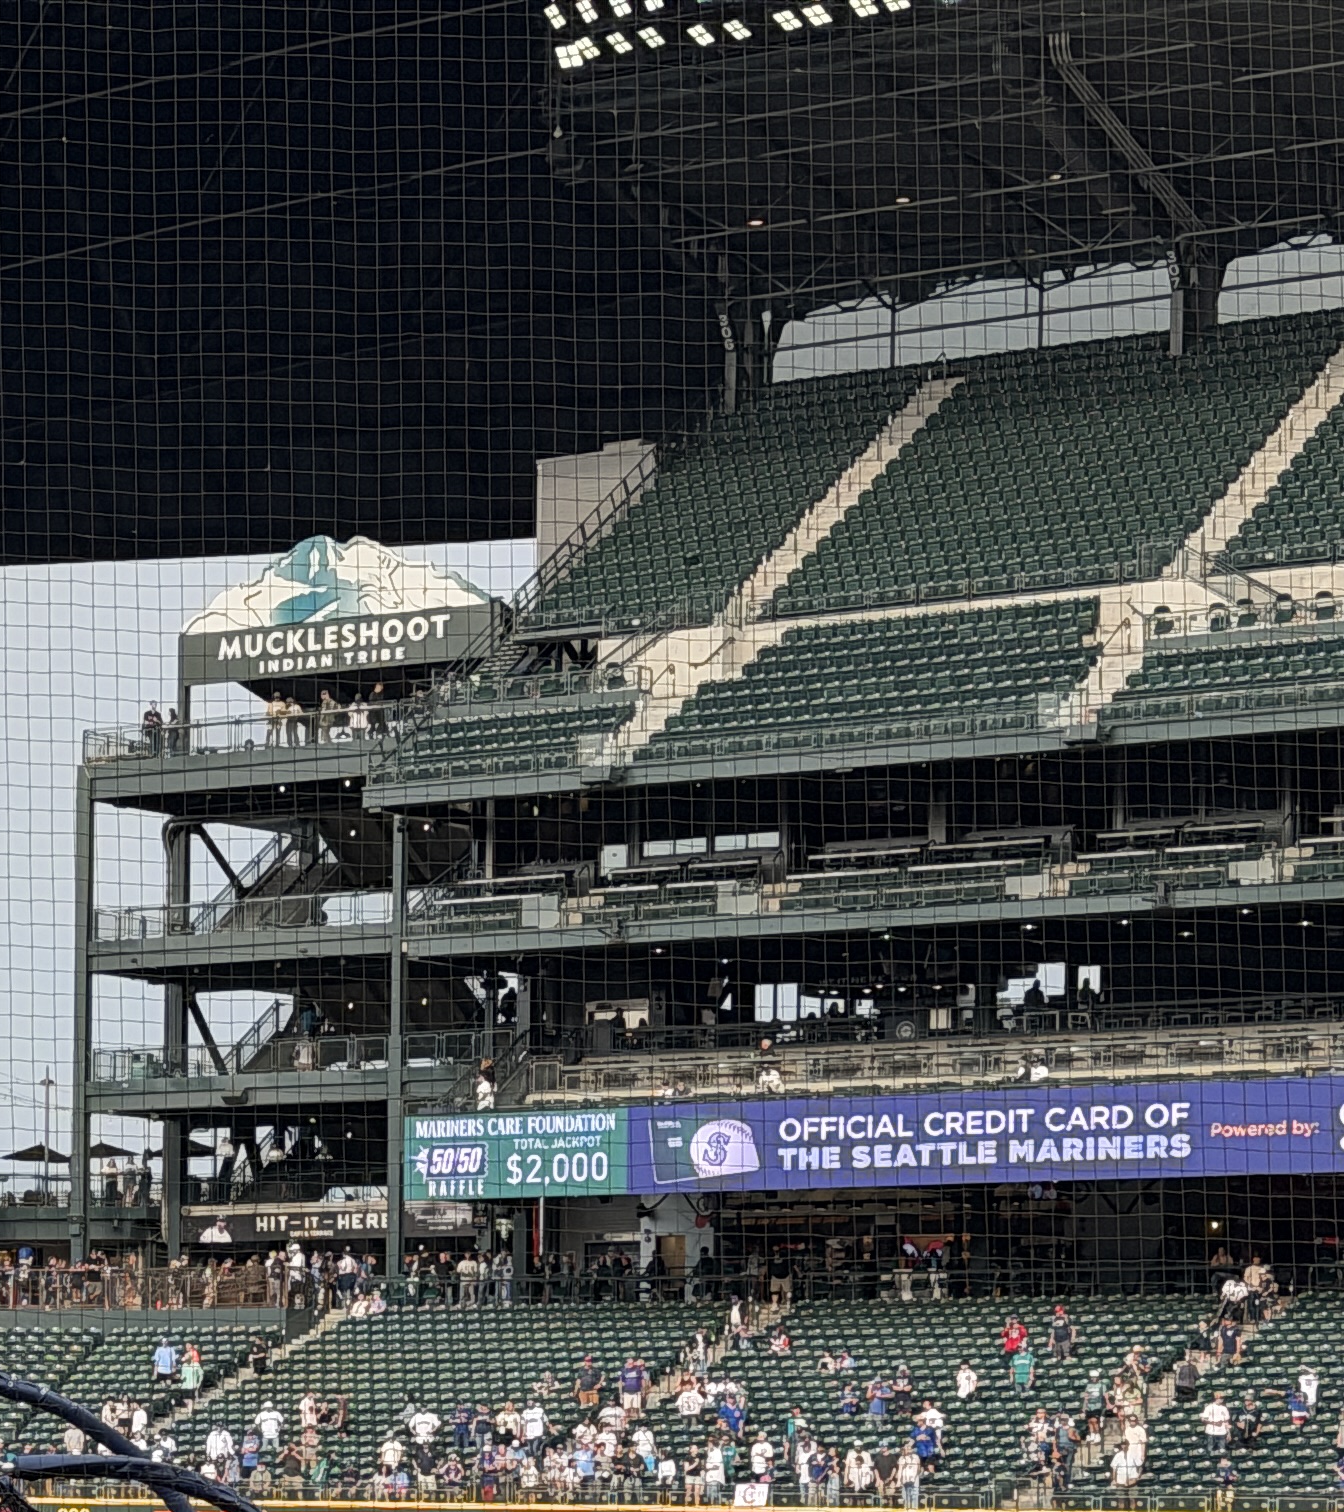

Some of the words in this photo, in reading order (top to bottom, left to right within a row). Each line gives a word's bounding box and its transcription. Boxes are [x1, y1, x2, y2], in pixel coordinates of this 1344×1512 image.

[218, 614, 451, 660] MUCKLESHOOT
[258, 653, 333, 674] INDIAN
[343, 646, 406, 666] TRIBE
[415, 1118, 484, 1139] MARINERS
[487, 1116, 523, 1136] CARE
[527, 1113, 616, 1134] FOUNDATION
[778, 1114, 913, 1142] OFFICIAL
[924, 1108, 1034, 1136] CREDIT
[1045, 1104, 1134, 1134] CARD
[1145, 1102, 1191, 1128] OF
[1211, 1120, 1287, 1138] Powered
[1291, 1119, 1320, 1137] by:
[513, 1138, 548, 1150] TOTAL
[551, 1136, 602, 1150] JACKPOT
[778, 1147, 843, 1171] THE
[852, 1140, 997, 1169] SEATTLE
[1009, 1134, 1191, 1164] MARINERS
[429, 1147, 483, 1174] 50/50
[506, 1152, 609, 1186] $2,000
[429, 1179, 484, 1197] RAFFLE
